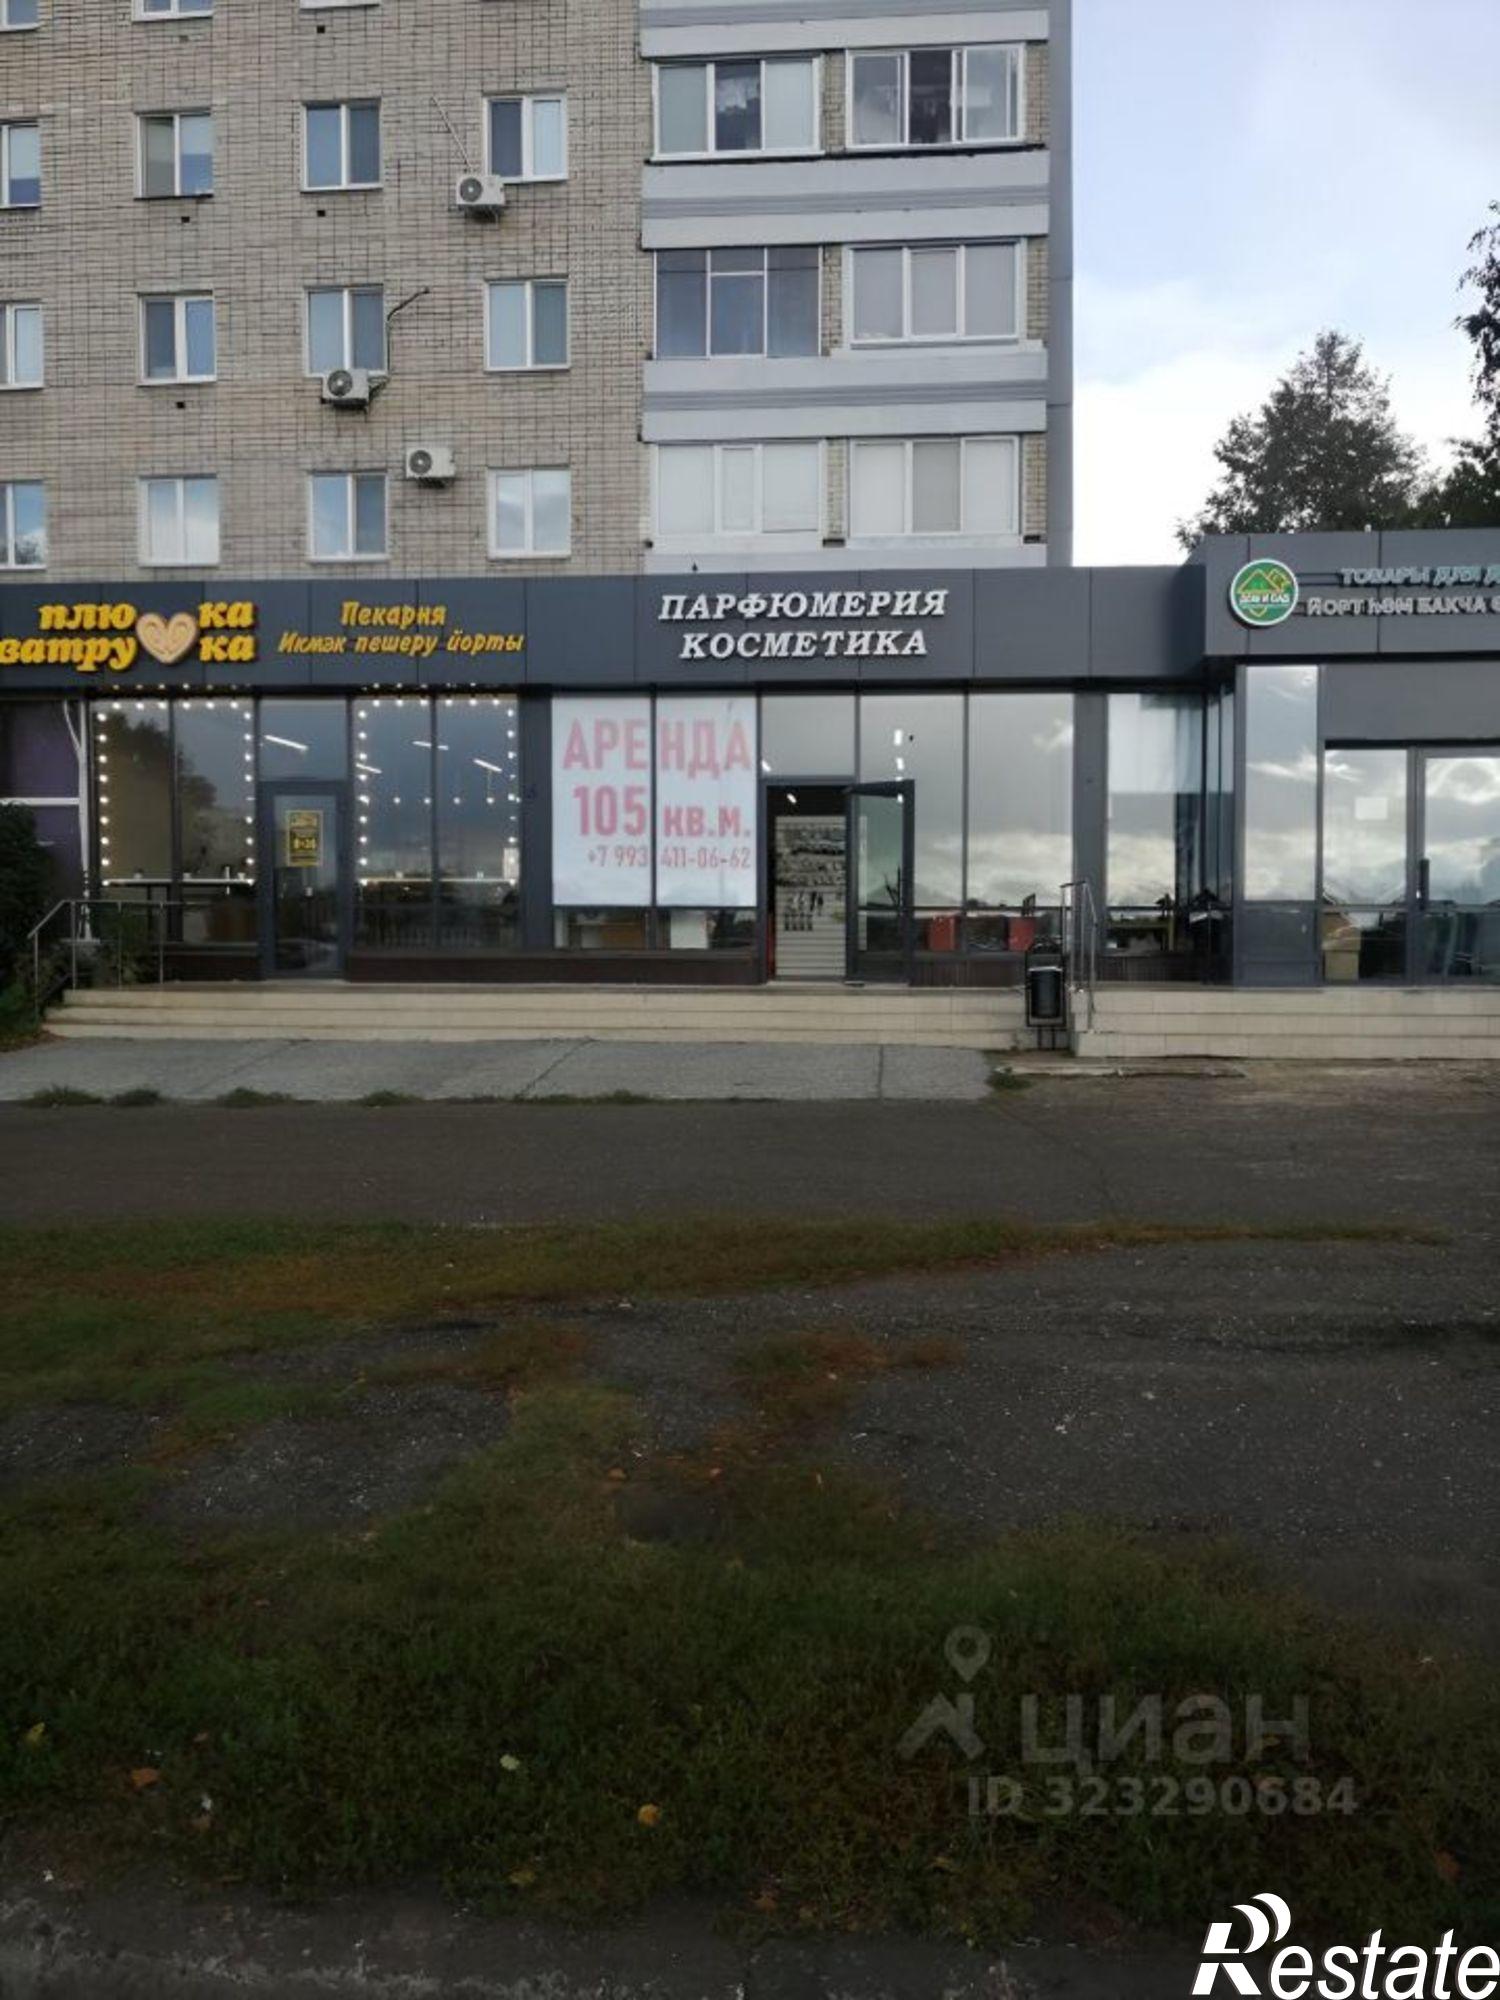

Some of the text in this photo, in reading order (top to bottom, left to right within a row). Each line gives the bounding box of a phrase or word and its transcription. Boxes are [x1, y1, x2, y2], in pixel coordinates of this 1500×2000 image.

[38, 603, 137, 630] плю
[341, 600, 447, 630] Пекарня
[658, 589, 948, 620] ПАРФЮМЕРИЯ
[1307, 596, 1364, 616] ЙОРТ
[1416, 594, 1487, 614] БАКЧА
[446, 630, 524, 656] йорты
[679, 629, 927, 659] КОСМЕТИКА
[563, 718, 750, 779] АРЕНДА
[573, 785, 646, 837] 105
[588, 846, 607, 868] +7
[614, 846, 648, 868] 993
